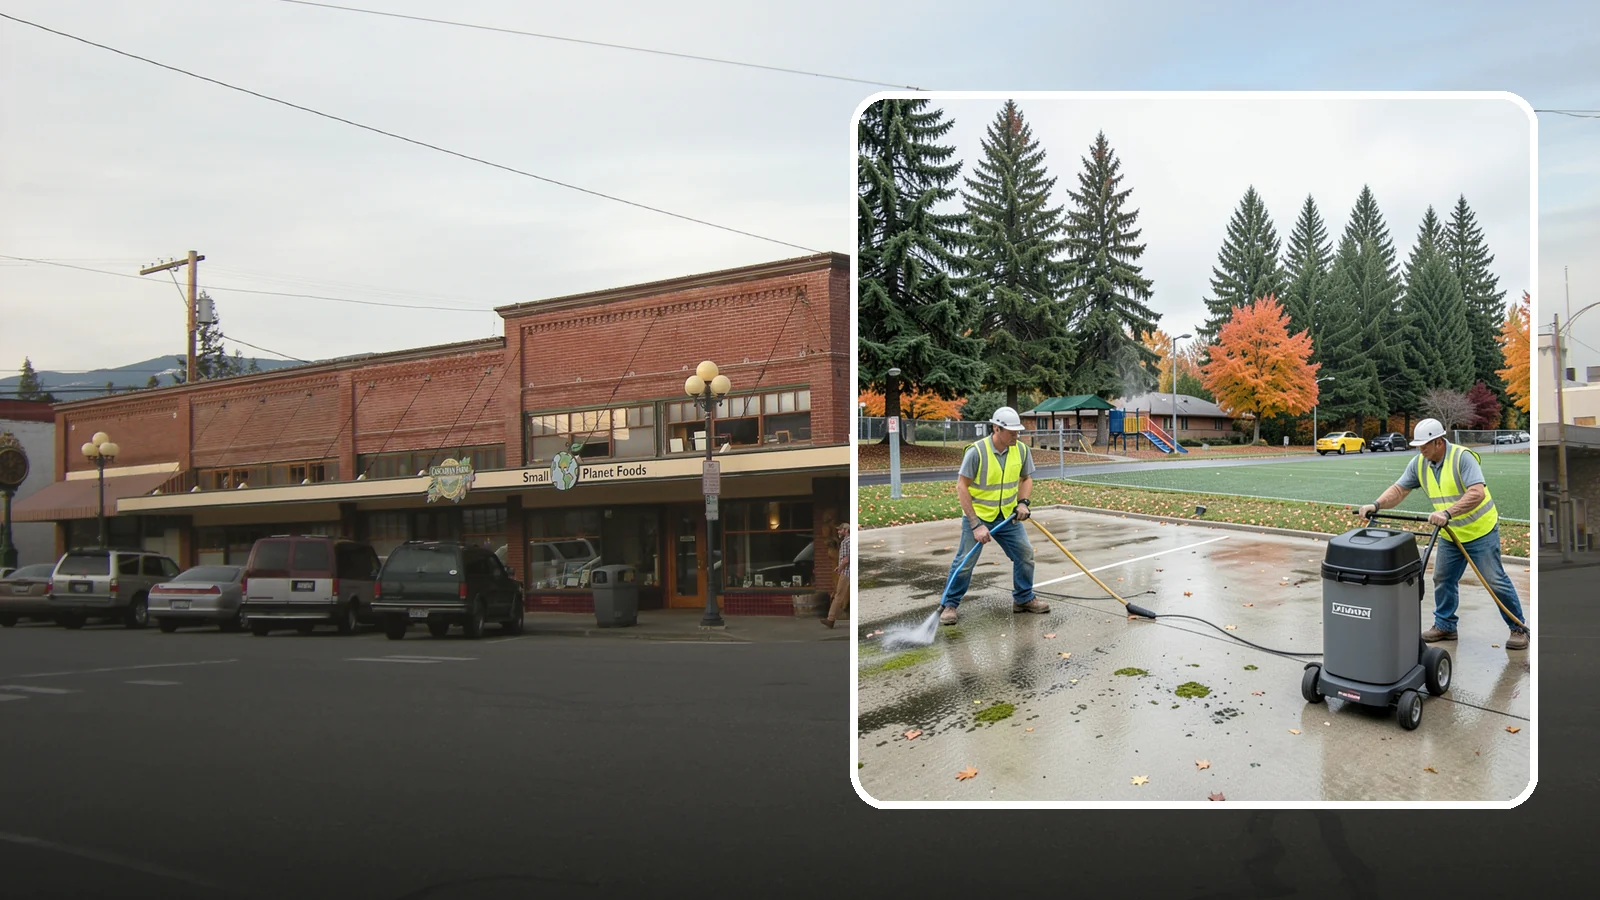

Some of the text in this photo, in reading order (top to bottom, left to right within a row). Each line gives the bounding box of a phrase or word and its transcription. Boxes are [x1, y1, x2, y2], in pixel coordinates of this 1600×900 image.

[523, 464, 647, 483] Small Planet Foods
